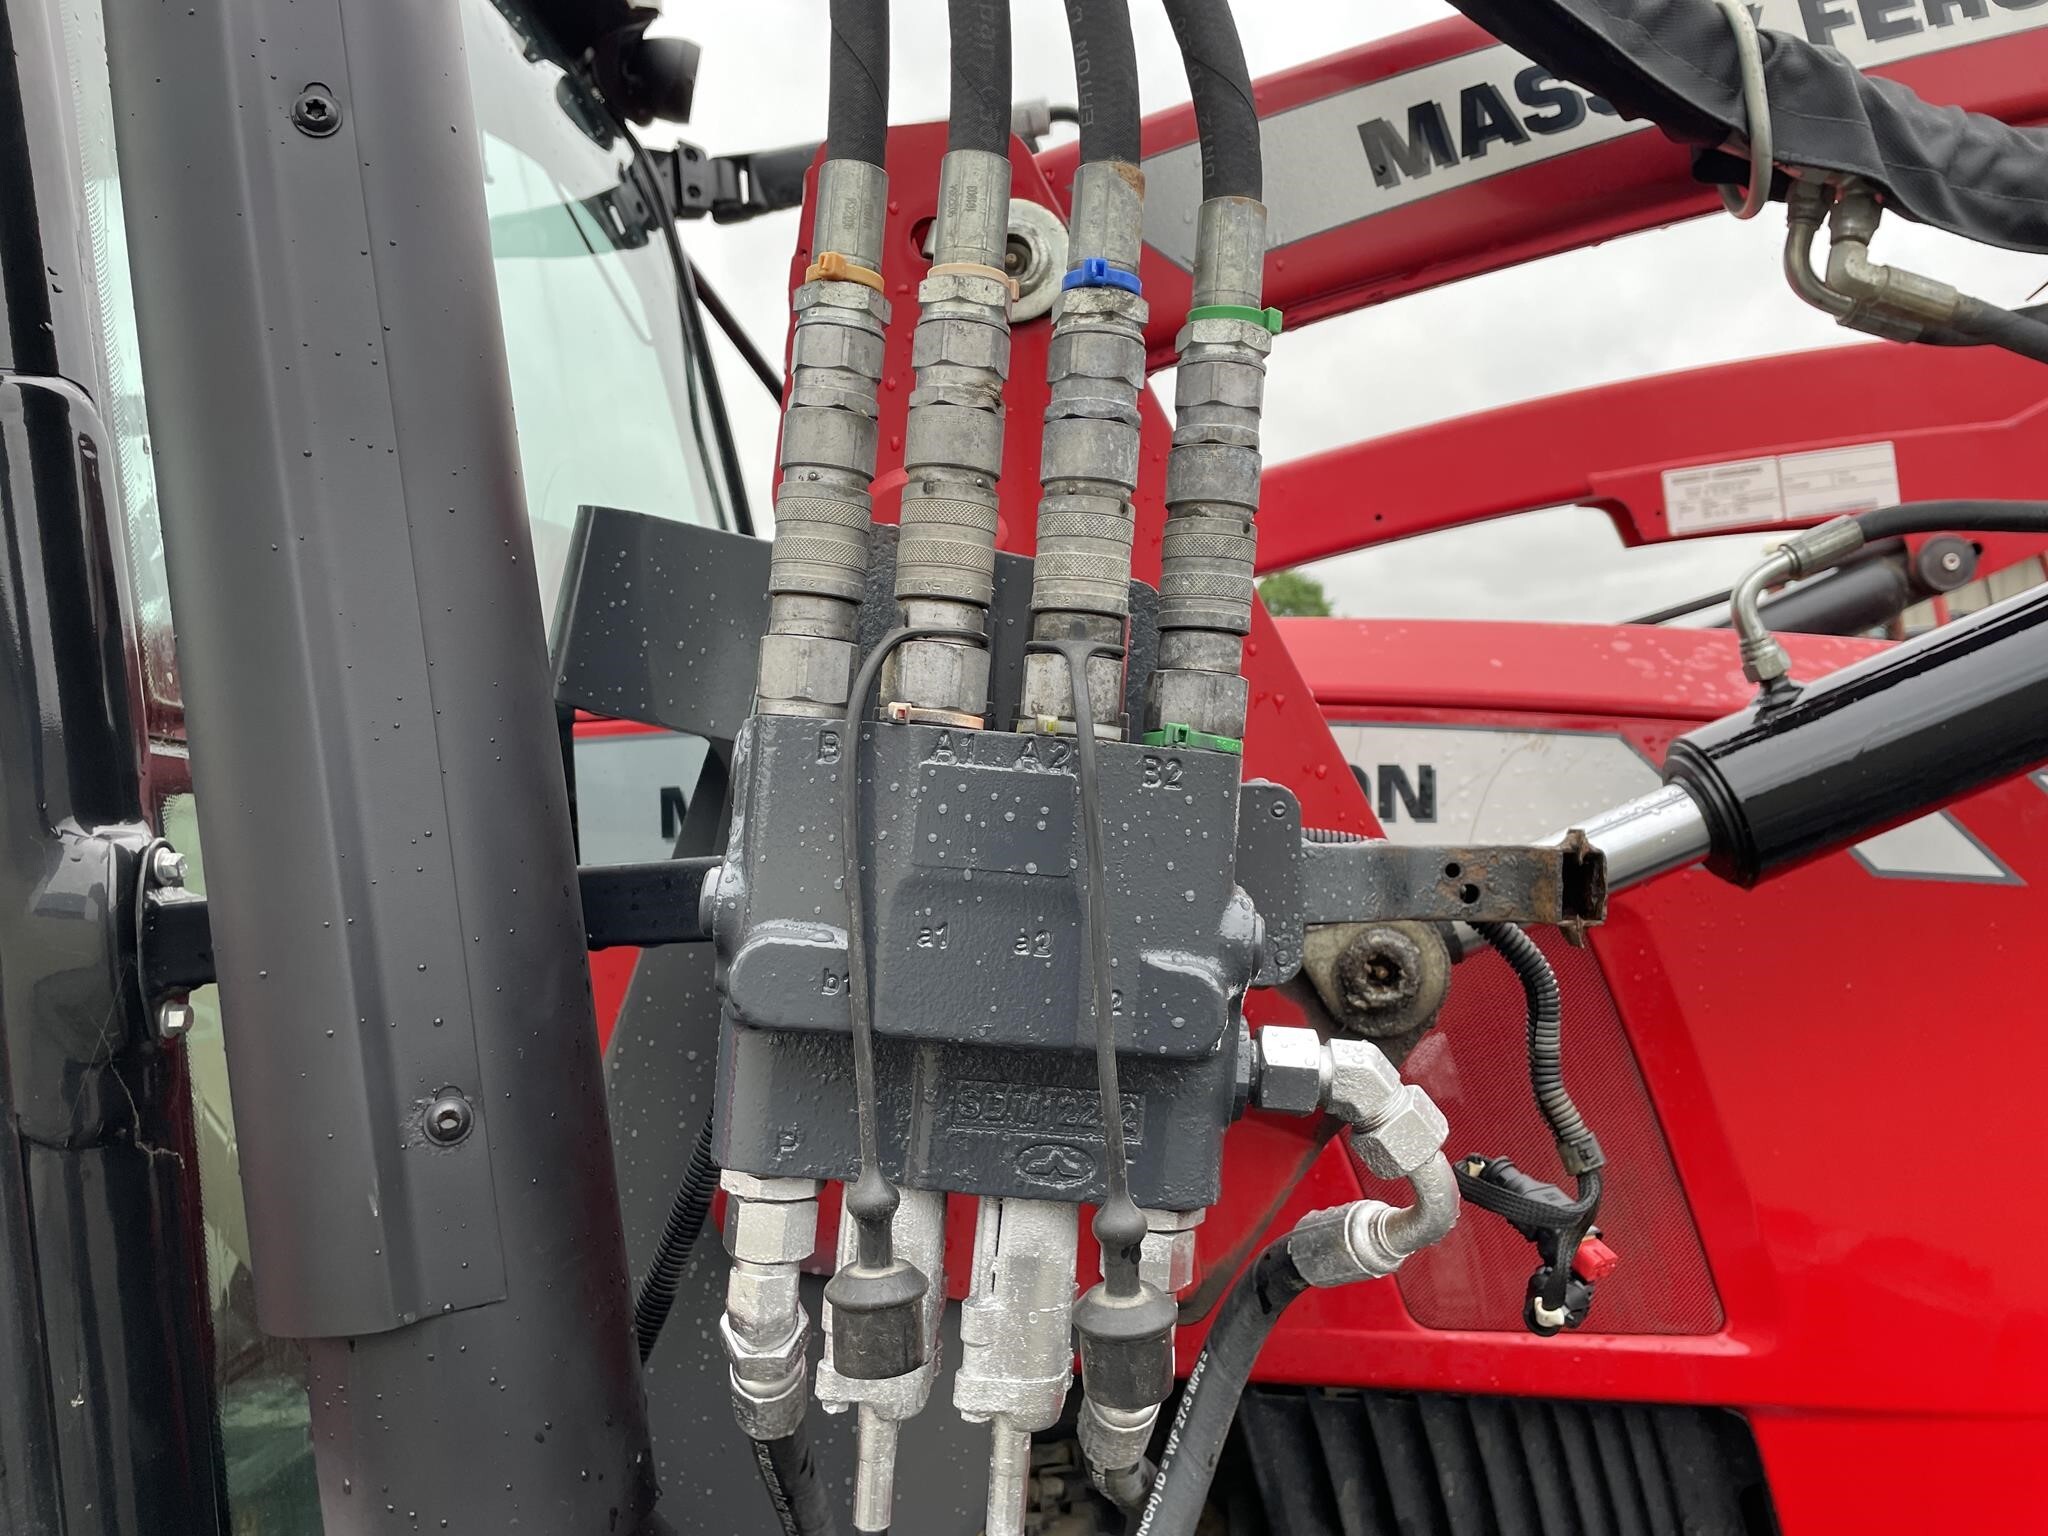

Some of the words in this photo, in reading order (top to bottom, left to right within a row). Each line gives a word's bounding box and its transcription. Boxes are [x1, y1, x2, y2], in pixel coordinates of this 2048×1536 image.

[1075, 39, 1094, 128] EATON
[1357, 64, 1620, 190] MAS
[928, 728, 976, 766] A1
[1012, 737, 1071, 774] A2
[1141, 754, 1183, 791] B2
[916, 922, 949, 950] a1
[1013, 929, 1053, 958] a2
[1154, 1471, 1168, 1491] ID
[1165, 1428, 1181, 1457] WP
[1174, 1393, 1193, 1431] 27.5
[1187, 1360, 1206, 1395] MPa
